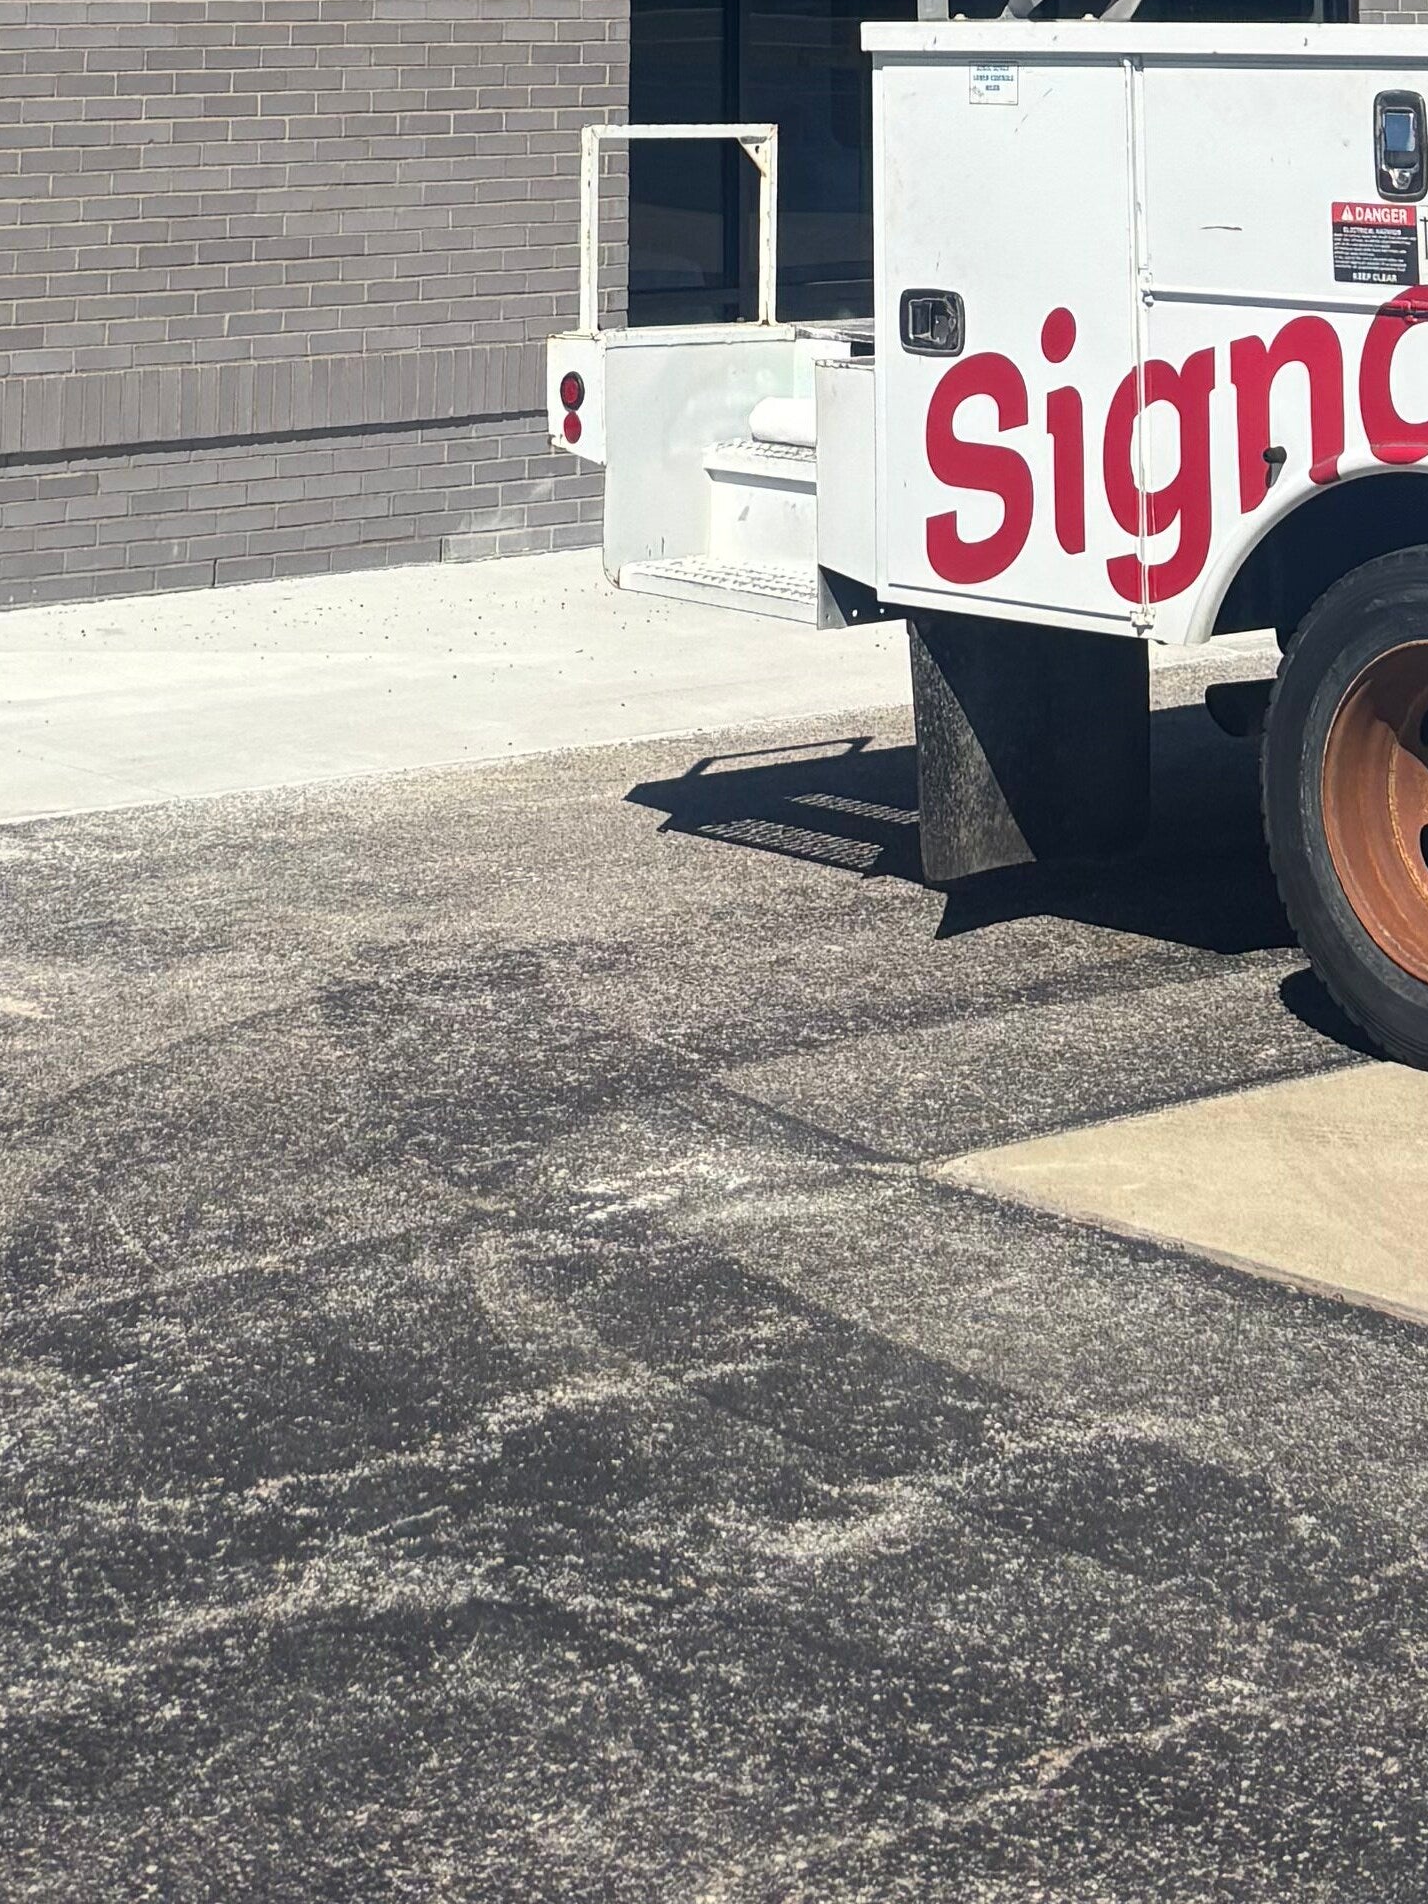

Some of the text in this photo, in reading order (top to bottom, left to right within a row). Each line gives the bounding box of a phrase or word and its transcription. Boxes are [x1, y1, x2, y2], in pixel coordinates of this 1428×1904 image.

[1355, 206, 1408, 224] DANGER
[1352, 272, 1398, 283] KEEP CLEAR
